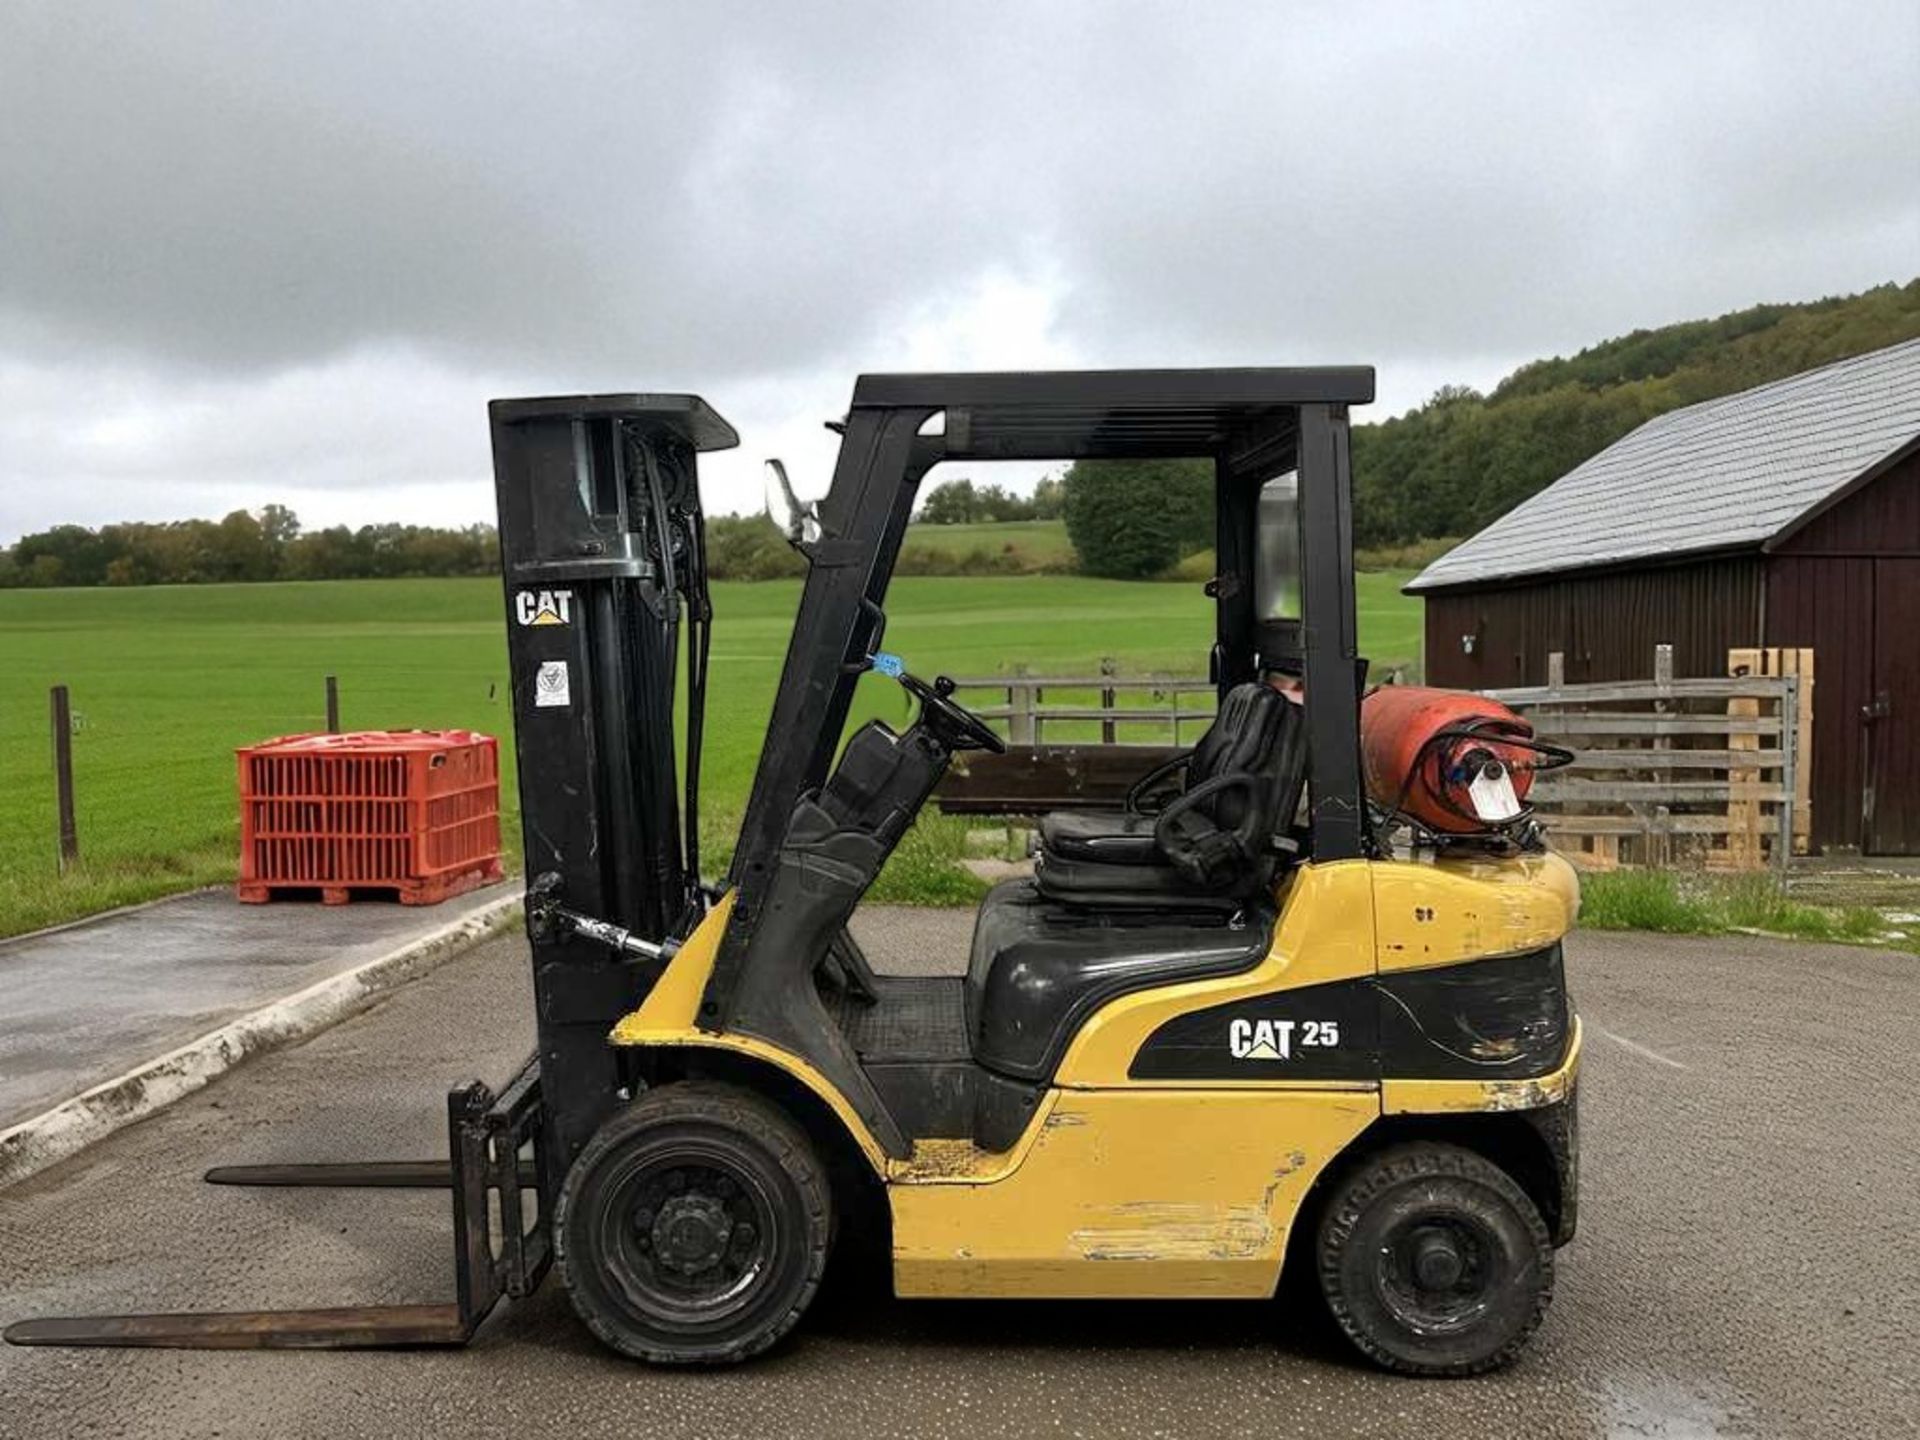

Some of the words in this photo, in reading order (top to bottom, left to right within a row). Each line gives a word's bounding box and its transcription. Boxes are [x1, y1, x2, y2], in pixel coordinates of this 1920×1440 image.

[515, 590, 572, 625] CAT
[1229, 1019, 1295, 1059] CAT
[1302, 1021, 1339, 1046] 25
